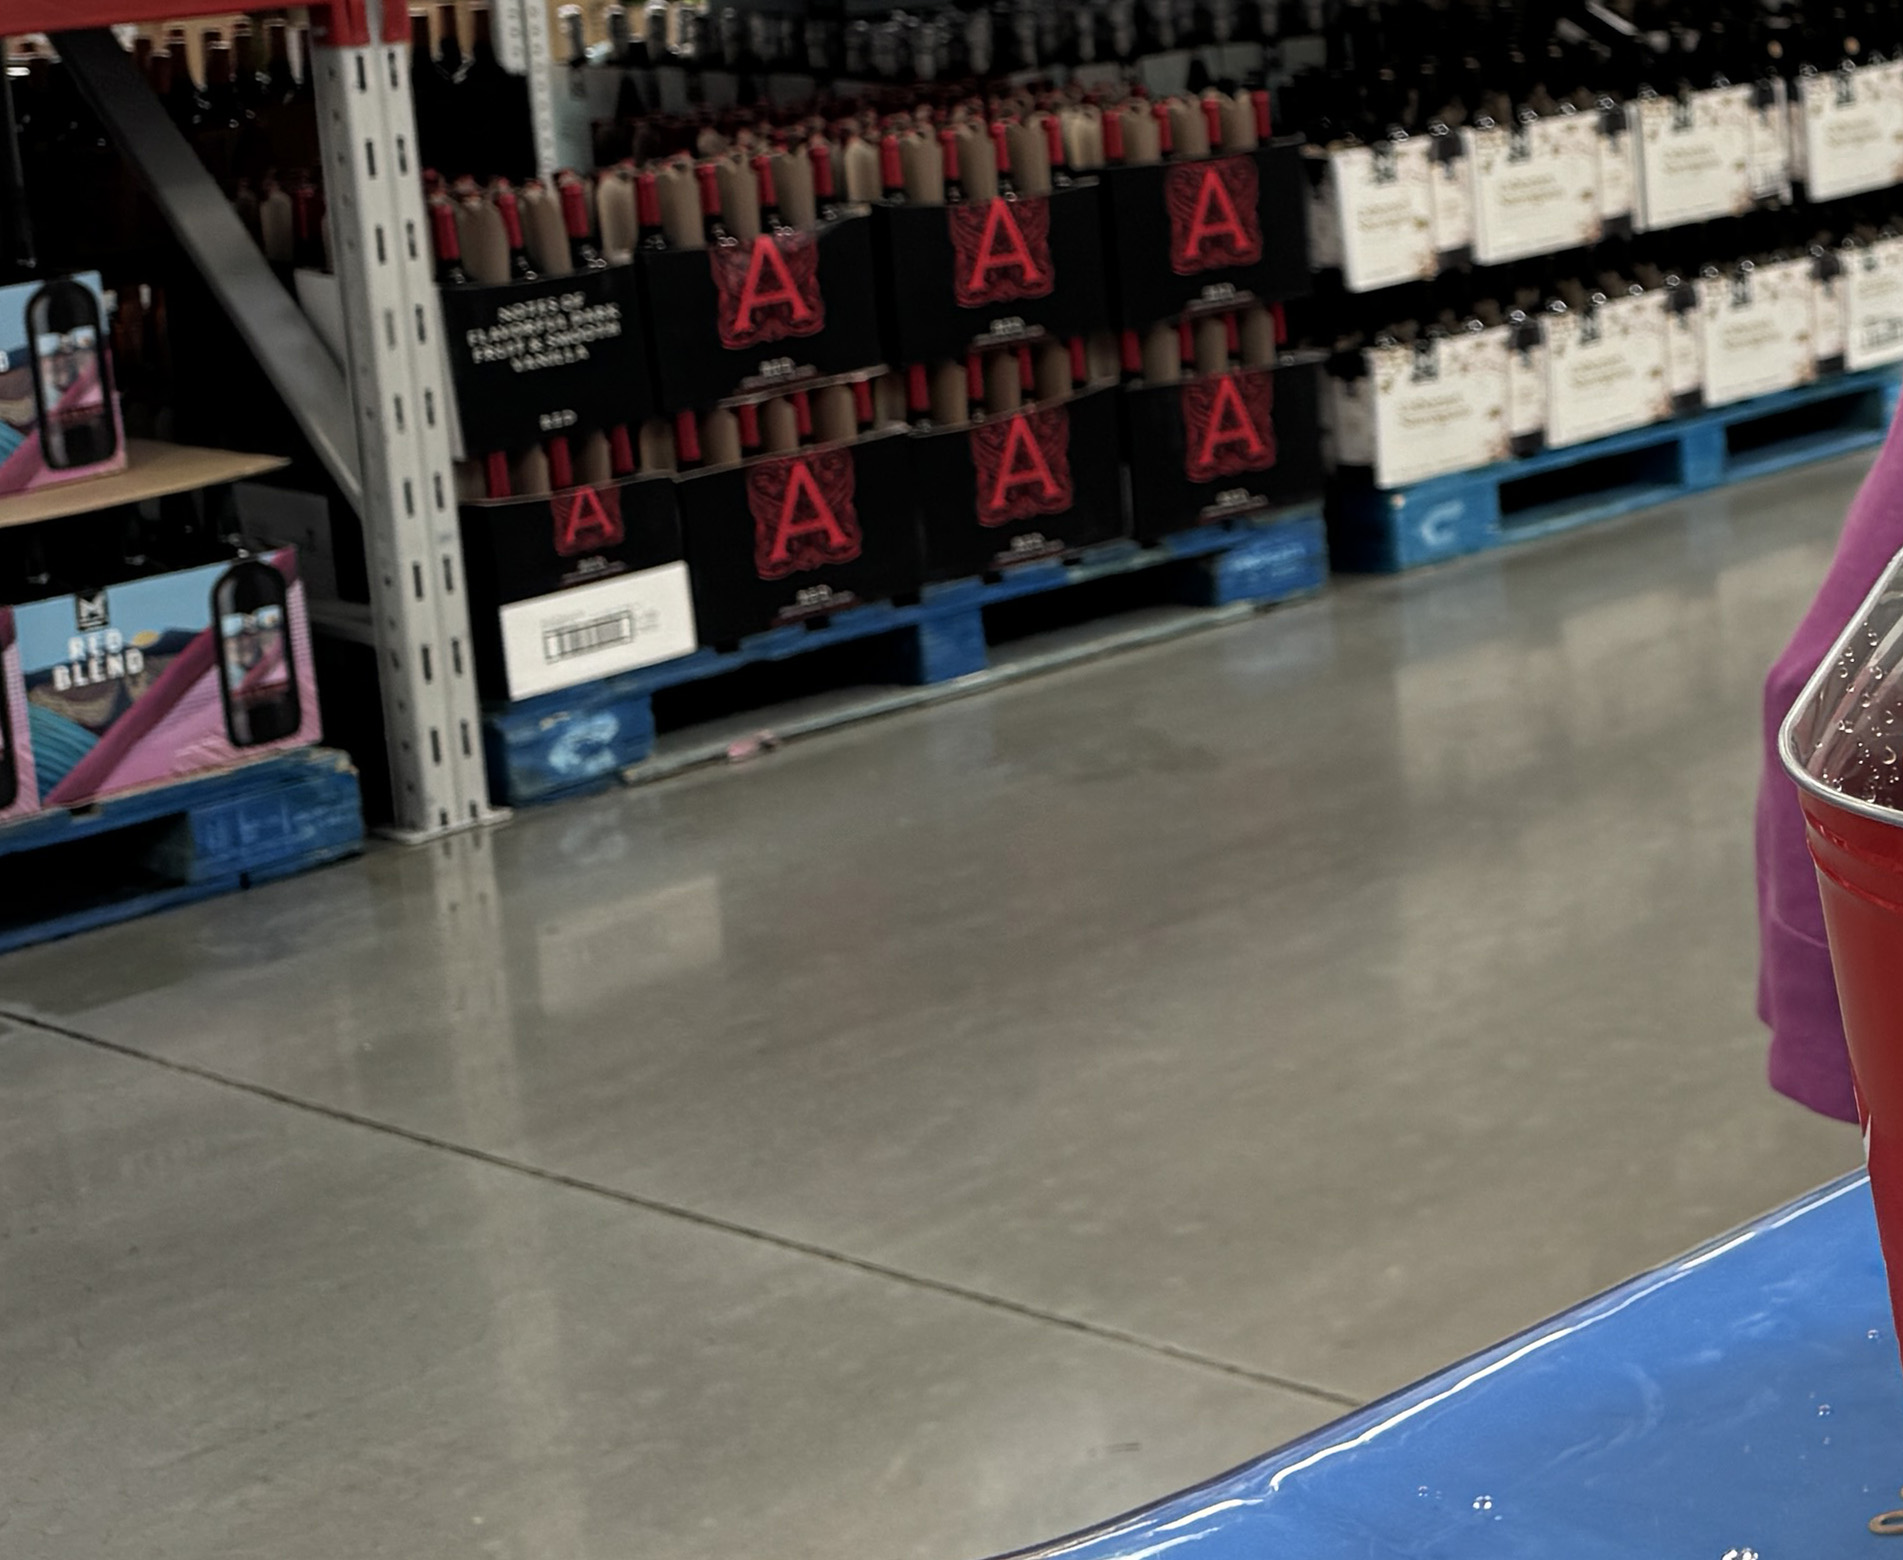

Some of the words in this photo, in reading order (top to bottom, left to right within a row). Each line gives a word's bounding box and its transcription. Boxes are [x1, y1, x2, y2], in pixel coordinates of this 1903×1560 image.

[1184, 168, 1250, 259] A
[969, 196, 1041, 291] A
[497, 296, 560, 322] NOTES
[560, 291, 586, 311] OF
[734, 234, 810, 333] A
[569, 302, 622, 329] DARK
[472, 337, 525, 364] FRUIT
[544, 320, 622, 347] SMOOTH
[510, 344, 590, 372] VANILLA
[539, 409, 578, 431] RED
[1199, 375, 1264, 465] A
[991, 414, 1061, 510] A
[565, 487, 613, 542] A
[770, 461, 850, 561] A
[52, 649, 145, 691] BLEND
[68, 629, 122, 662] RED
